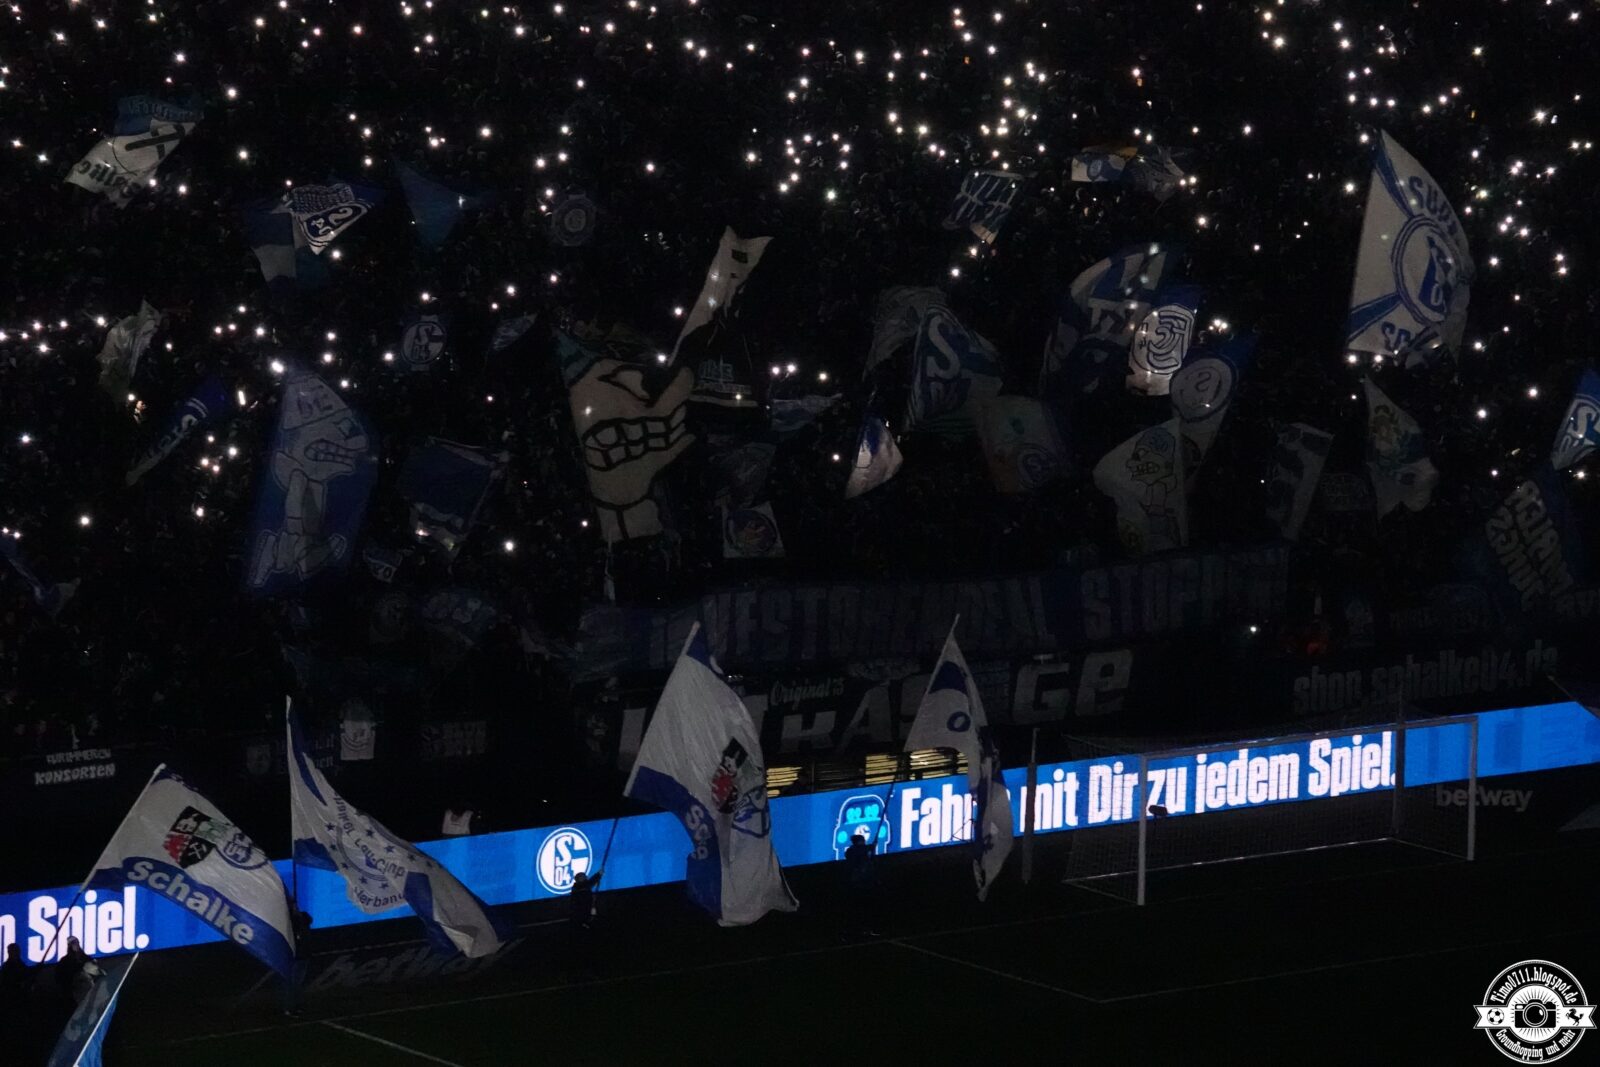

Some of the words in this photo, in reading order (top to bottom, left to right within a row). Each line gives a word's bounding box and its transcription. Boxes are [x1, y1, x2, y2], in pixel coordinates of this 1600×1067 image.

[1020, 768, 1079, 833] mit
[1088, 761, 1138, 823] Dir
[1147, 766, 1187, 817] zu
[1195, 748, 1300, 813] jedem
[27, 885, 149, 963] Spiel.
[126, 859, 255, 947] Schalke
